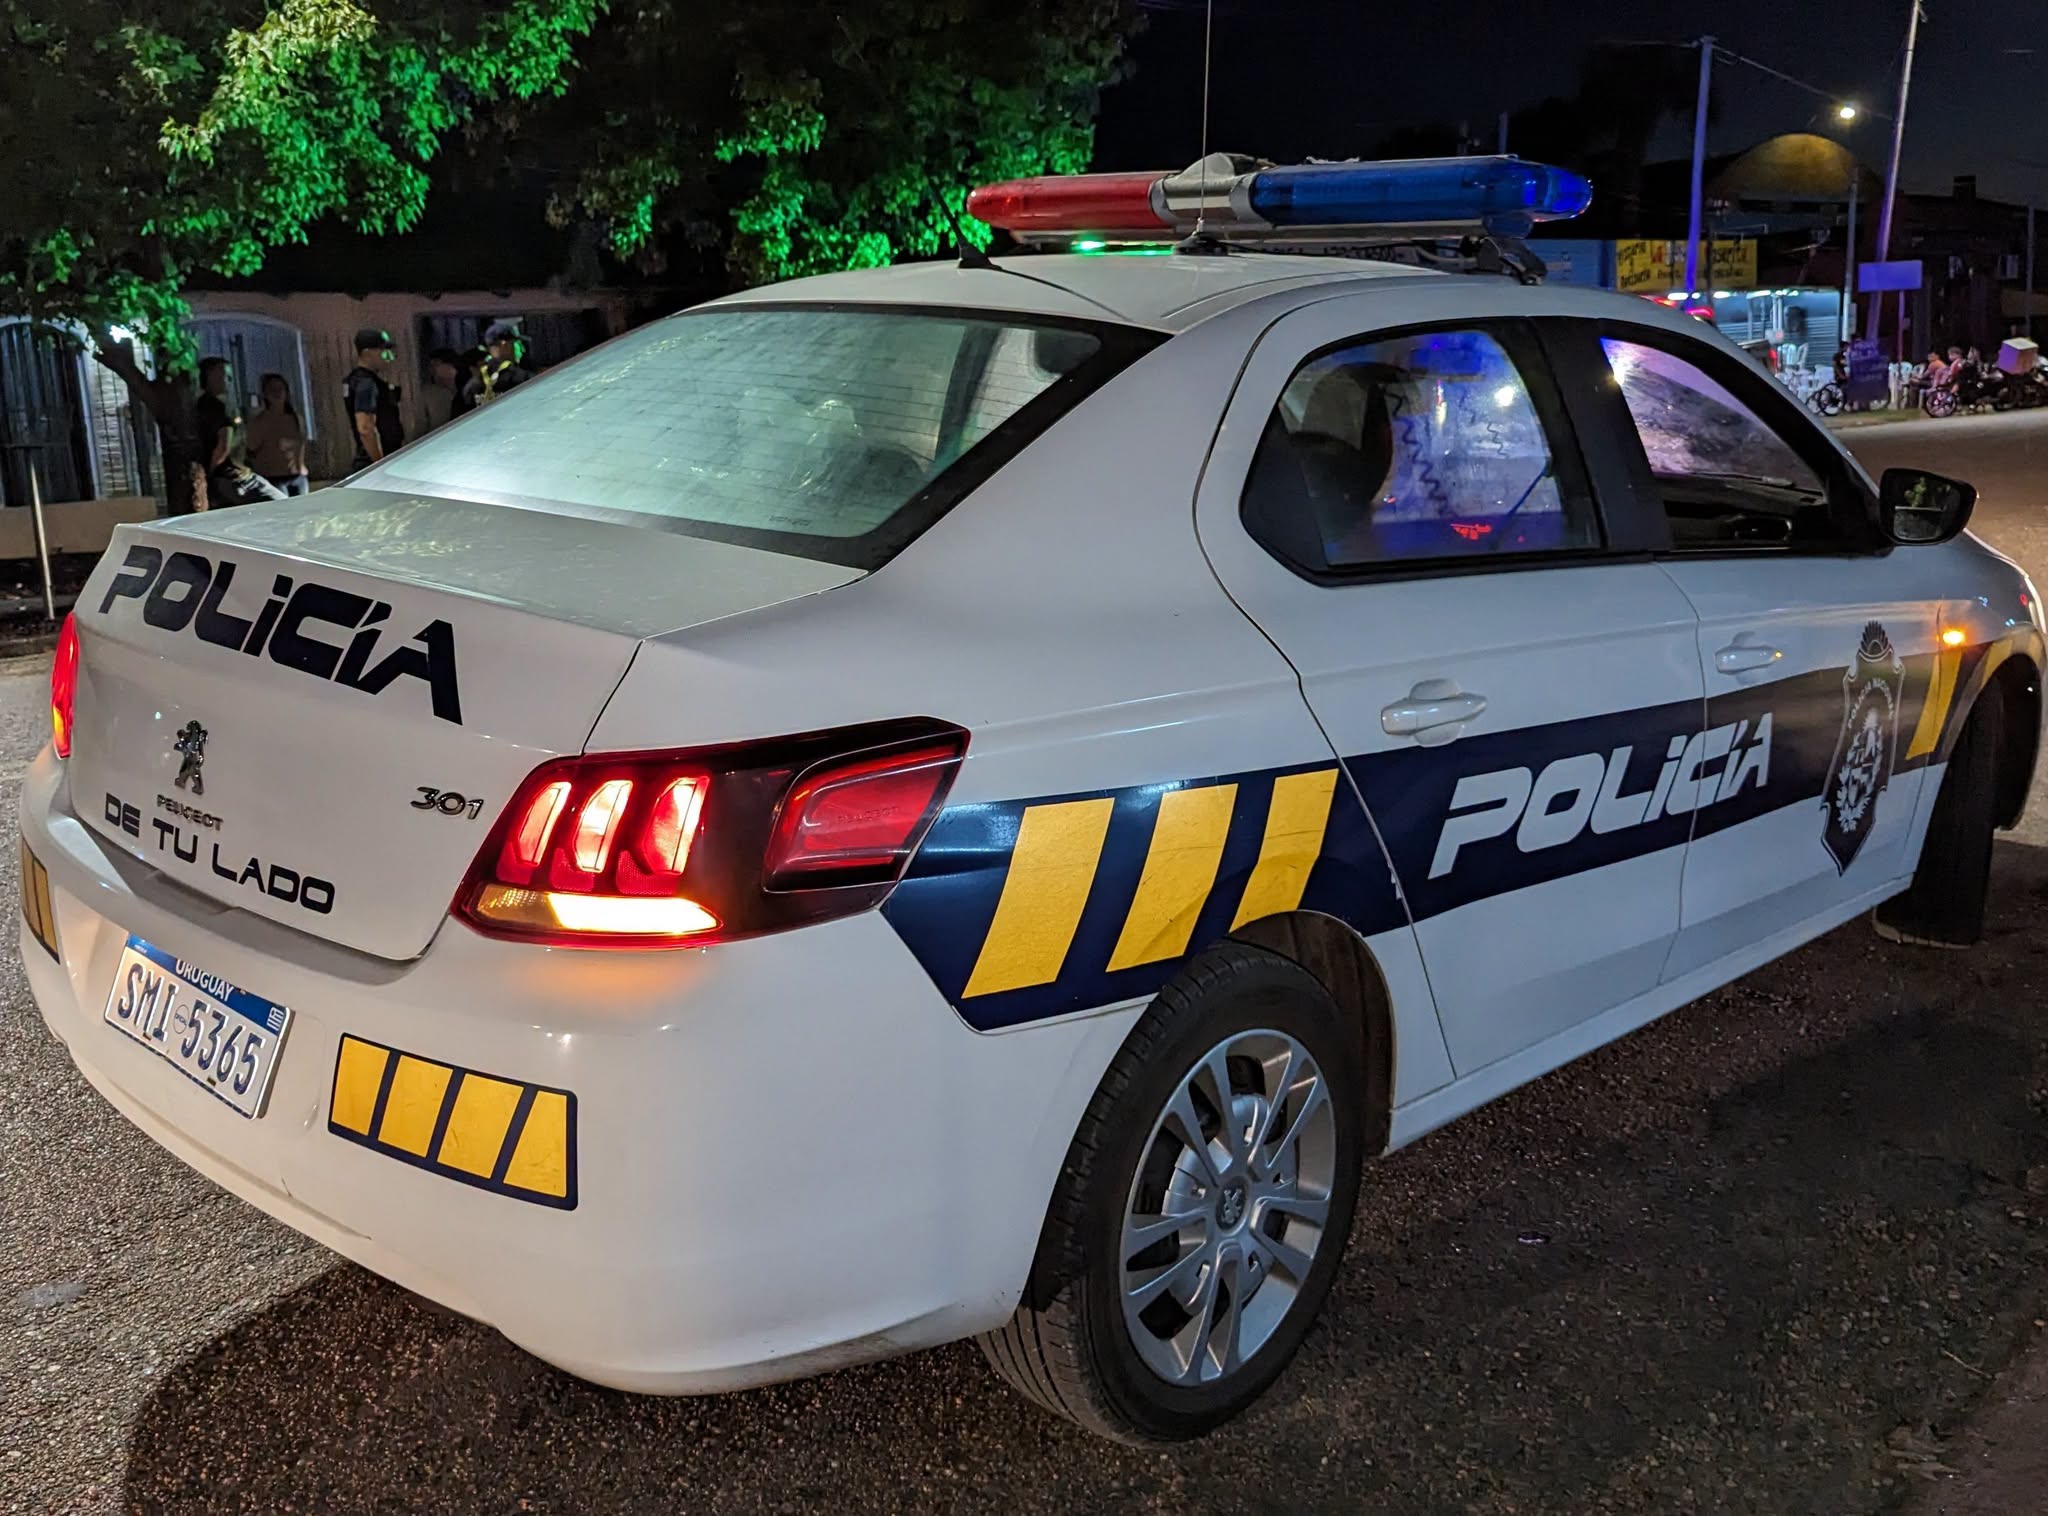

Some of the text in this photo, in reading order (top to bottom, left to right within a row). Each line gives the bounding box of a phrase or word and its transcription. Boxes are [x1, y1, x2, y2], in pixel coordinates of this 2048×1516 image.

[156, 793, 224, 831] PEUGEOT
[409, 785, 485, 821] 301
[104, 791, 336, 915] DE TU LADO
[175, 958, 235, 1003] URUGUAY
[118, 963, 265, 1095] SMI 5365
